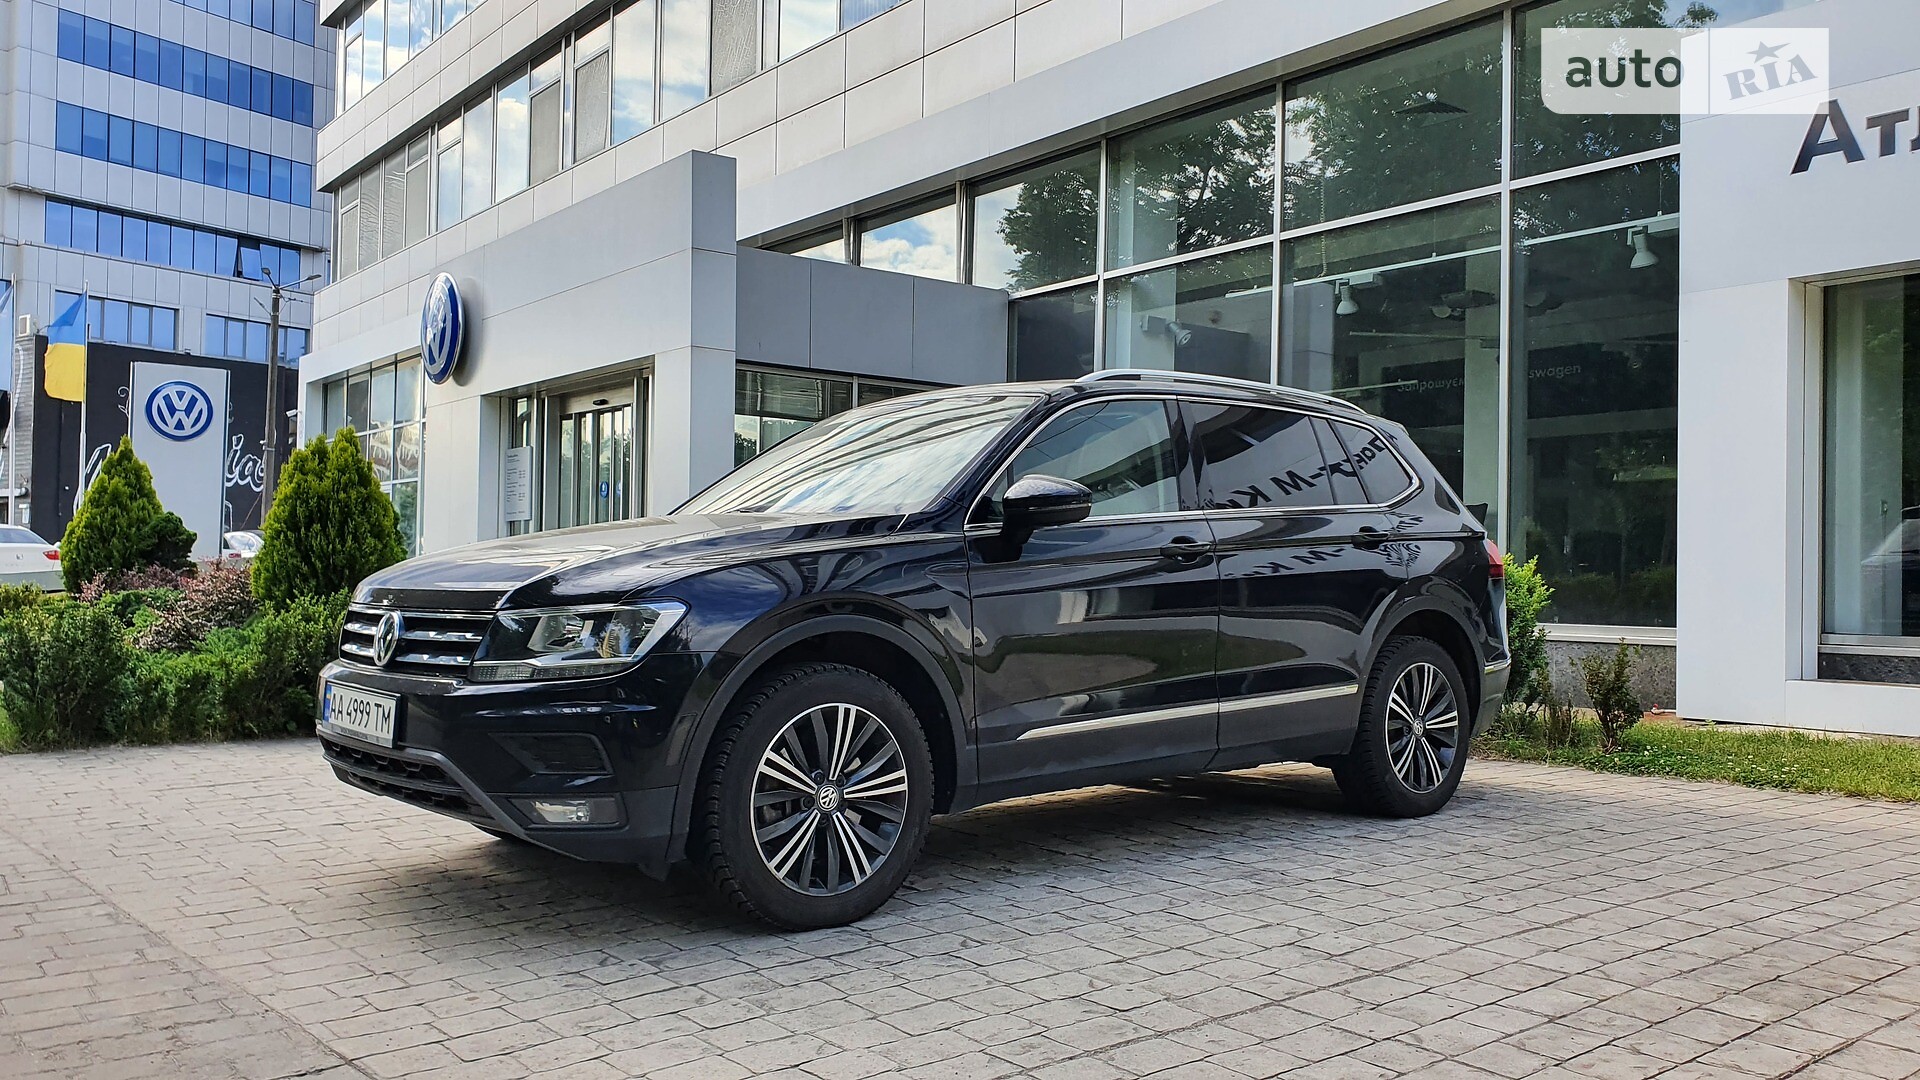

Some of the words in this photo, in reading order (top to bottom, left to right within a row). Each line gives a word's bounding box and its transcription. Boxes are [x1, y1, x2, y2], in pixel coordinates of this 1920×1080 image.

[1790, 98, 1920, 176] Ат
[1397, 377, 1464, 394] Запрошуєм
[1528, 365, 1582, 379] swagen
[151, 384, 209, 437] VW
[329, 693, 344, 722] AA
[346, 697, 371, 729] 4999
[374, 702, 392, 734] TM
